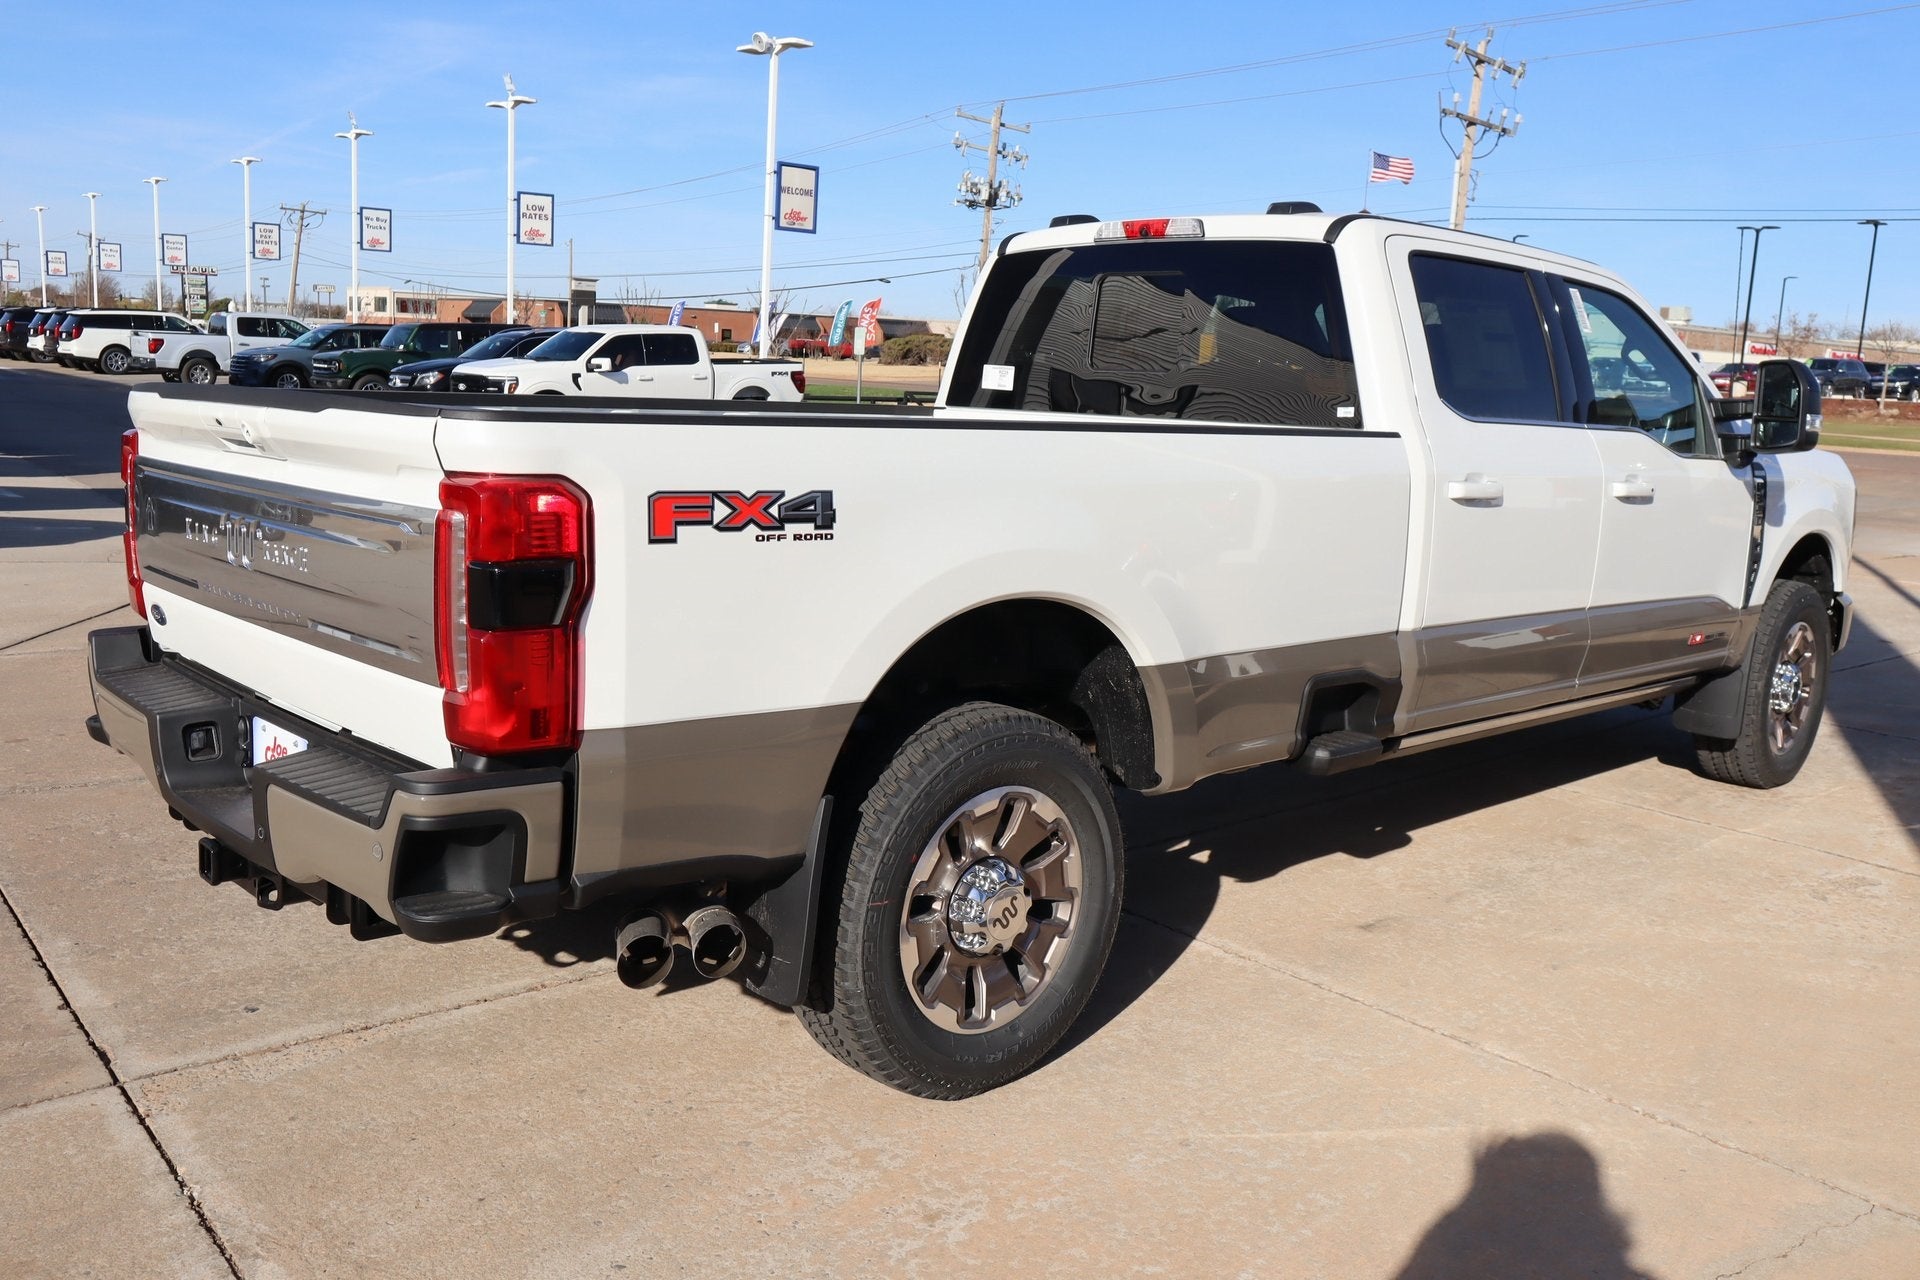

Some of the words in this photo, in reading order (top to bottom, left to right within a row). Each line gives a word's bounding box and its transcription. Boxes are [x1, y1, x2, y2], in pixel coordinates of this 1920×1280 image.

[781, 186, 813, 198] WELCOME
[526, 204, 545, 212] LOW
[375, 216, 388, 224] Buy
[522, 212, 549, 221] RATES
[783, 212, 808, 222] Cooper
[366, 223, 387, 231] Trucks
[648, 490, 836, 544] FX4
[755, 533, 787, 542] OFF
[793, 532, 834, 541] ROAD
